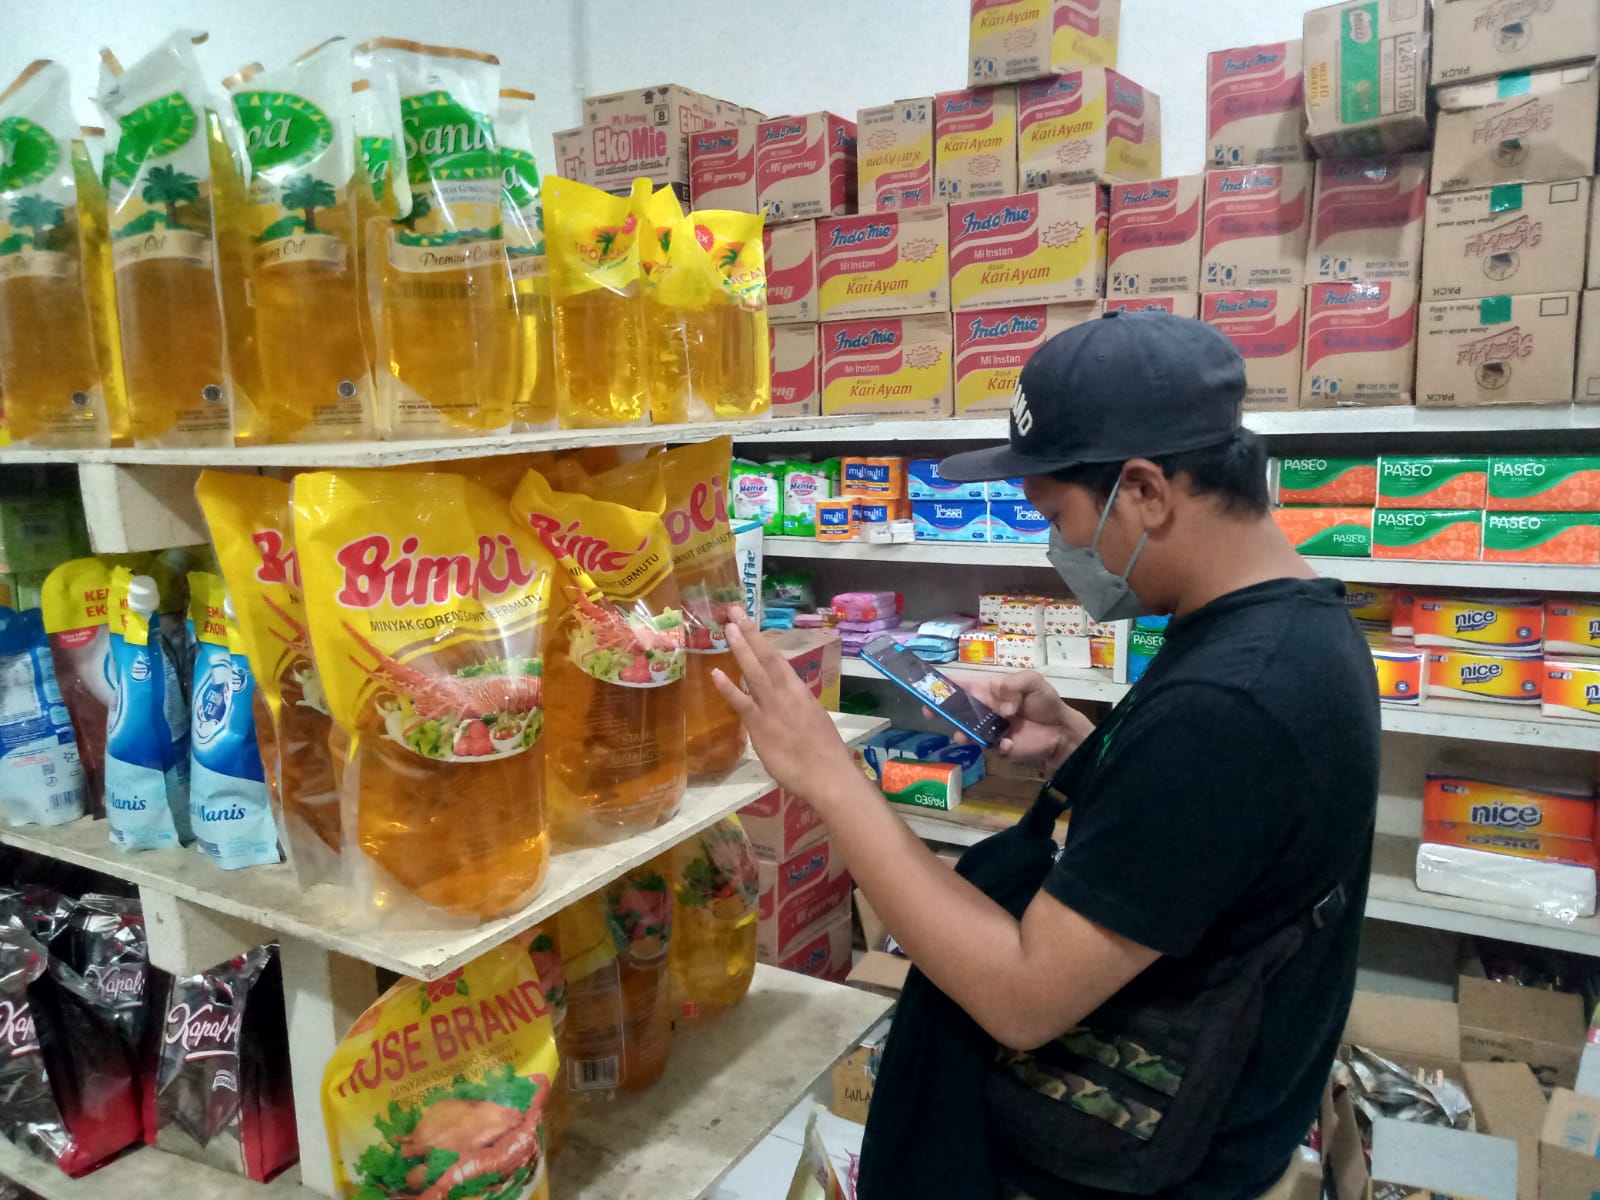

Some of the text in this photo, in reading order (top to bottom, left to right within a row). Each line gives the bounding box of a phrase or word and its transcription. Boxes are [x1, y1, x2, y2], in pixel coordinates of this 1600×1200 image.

[981, 8, 1039, 29] Kari Ayam
[1441, 66, 1470, 78] PACK
[1031, 119, 1093, 142] Kari Ayam
[944, 135, 1002, 152] Kari Ayam
[974, 247, 1013, 259] Mi Instan
[850, 260, 875, 270] Instan
[981, 266, 1050, 285] Kari Ayam
[846, 278, 909, 295] Kari Ayam
[1433, 286, 1461, 296] PACK
[981, 354, 1020, 365] Mi Instan
[855, 364, 880, 373] Instan
[987, 377, 1017, 390] Kari
[850, 384, 912, 398] Kari Ayam
[1426, 393, 1455, 402] PACK
[1284, 459, 1327, 471] PASEO
[1384, 464, 1432, 477] PASEO
[1494, 463, 1545, 477] PASEO
[740, 484, 768, 493] Merries
[790, 482, 817, 492] Merries
[664, 476, 729, 546] oli
[824, 511, 844, 522] multi
[934, 504, 962, 519] Tessa
[1378, 514, 1425, 527] PASEO
[1490, 516, 1541, 529] PASEO
[1333, 534, 1365, 543] PASEO
[1455, 609, 1496, 627] nice
[370, 619, 414, 632] MINYAK
[1460, 662, 1501, 679] nice
[914, 794, 945, 808] PASEO
[1471, 801, 1541, 826] nice
[0, 1001, 35, 1047] Kap
[165, 1002, 225, 1051] Kapal
[431, 980, 549, 1062] BRAND
